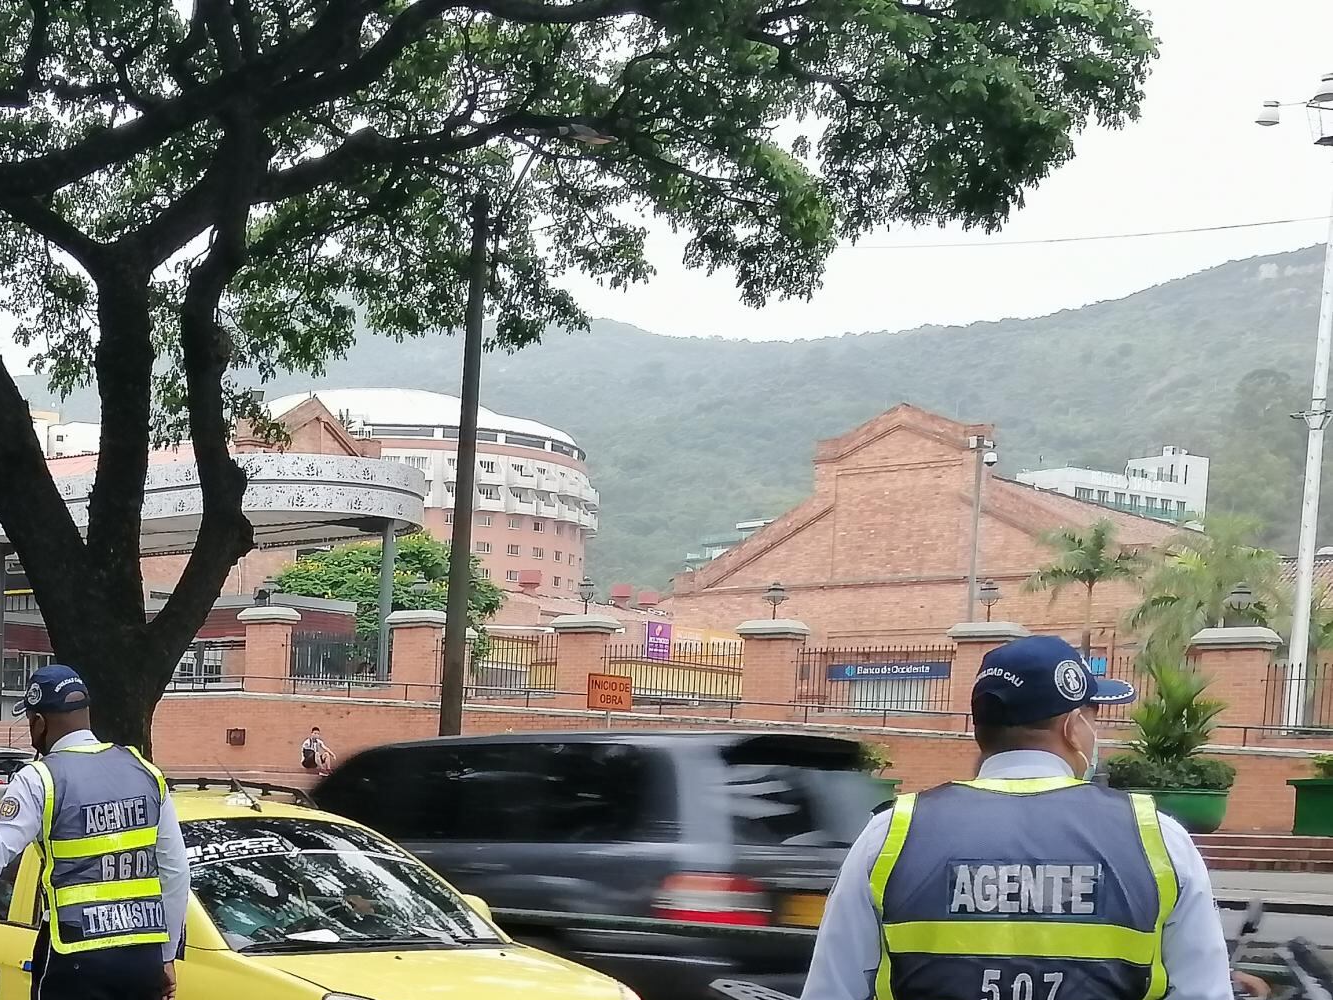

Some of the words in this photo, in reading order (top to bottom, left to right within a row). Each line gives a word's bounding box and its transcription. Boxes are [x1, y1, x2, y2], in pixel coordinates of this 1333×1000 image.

[857, 665, 880, 675] Banco
[892, 665, 930, 674] Occidente
[1003, 671, 1024, 688] CALI
[591, 679, 617, 691] INICIO
[619, 682, 630, 693] DE
[600, 693, 623, 705] OBRA
[86, 798, 146, 834] AGENTE
[102, 850, 148, 881] 660
[950, 863, 1095, 914] AGENTE
[83, 900, 164, 934] TRANSITO
